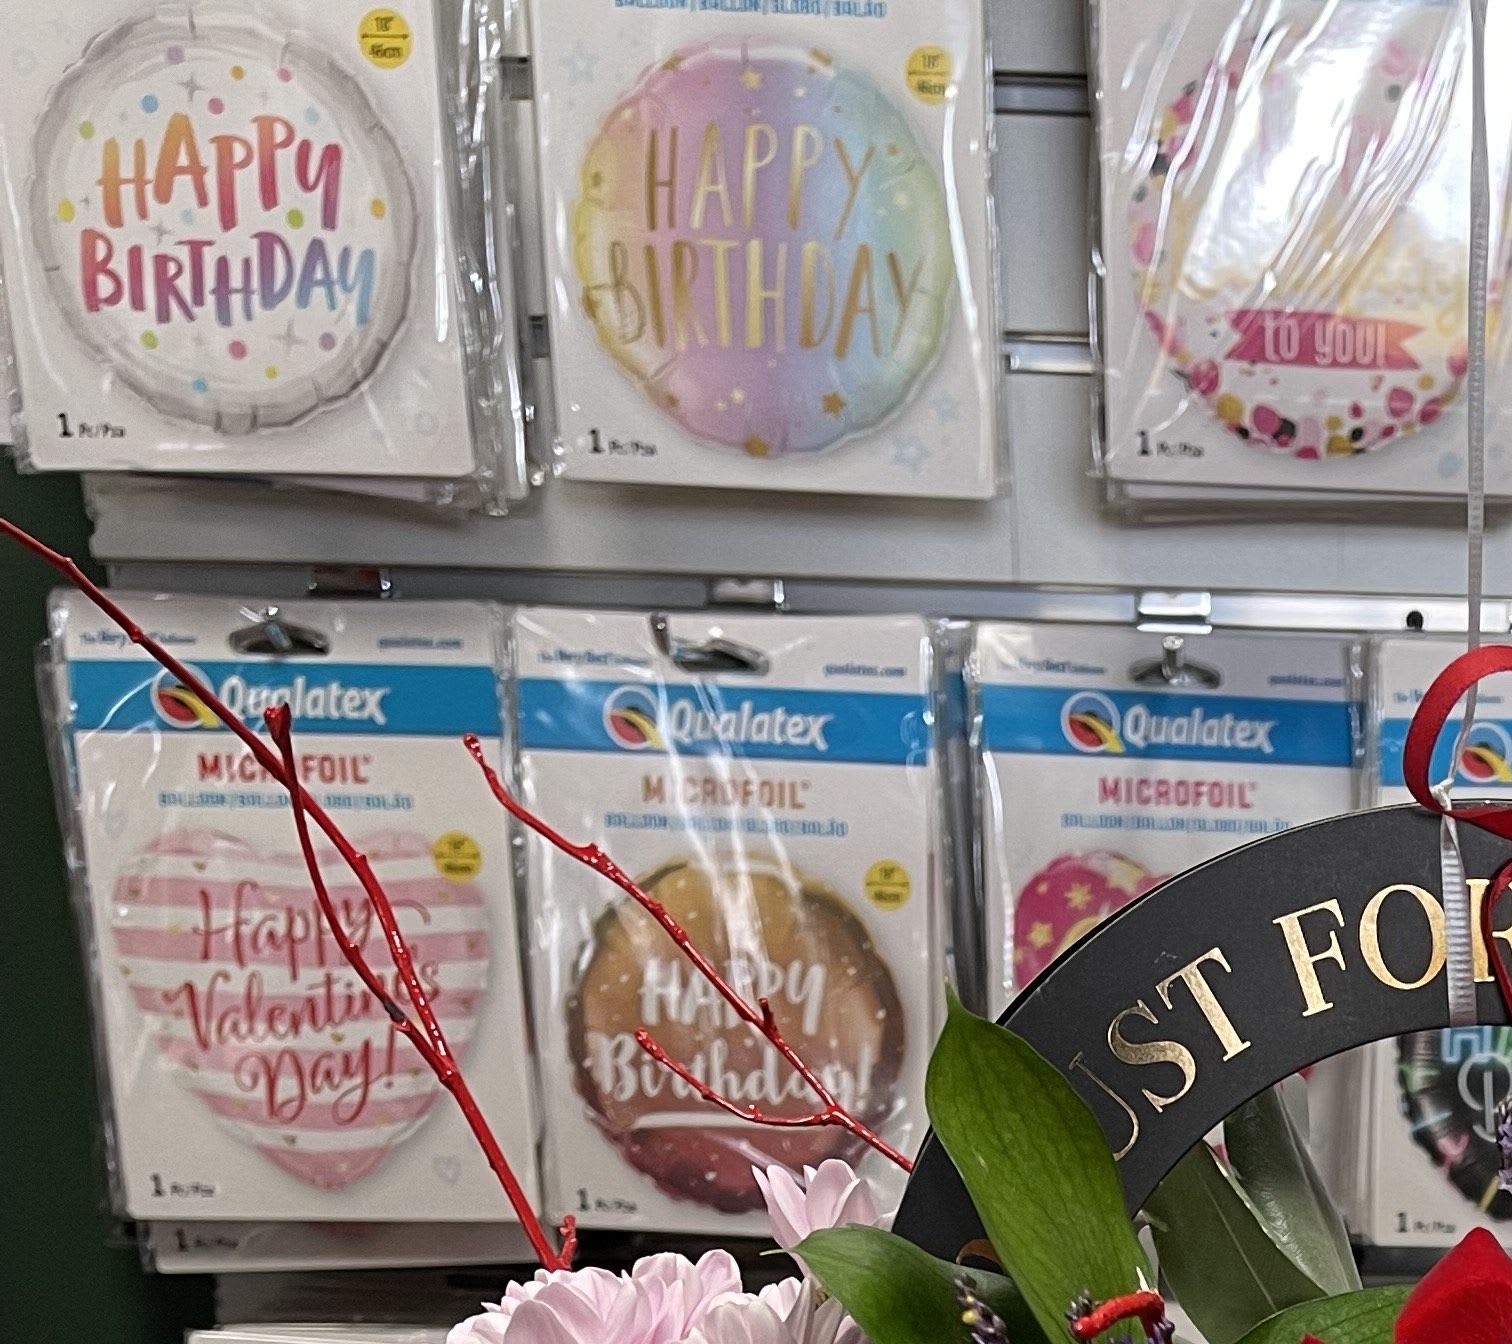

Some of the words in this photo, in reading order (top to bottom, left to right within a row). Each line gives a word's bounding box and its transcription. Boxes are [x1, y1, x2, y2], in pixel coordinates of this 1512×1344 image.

[96, 112, 342, 231] HAPPY
[645, 122, 874, 240] HAPPY
[80, 228, 376, 327] BIRTHDAY
[608, 238, 923, 361] BIRTHDAY
[1264, 328, 1300, 361] to
[1315, 323, 1387, 367] you!
[668, 699, 834, 752] Qualatex
[1122, 704, 1277, 754] Qualatex
